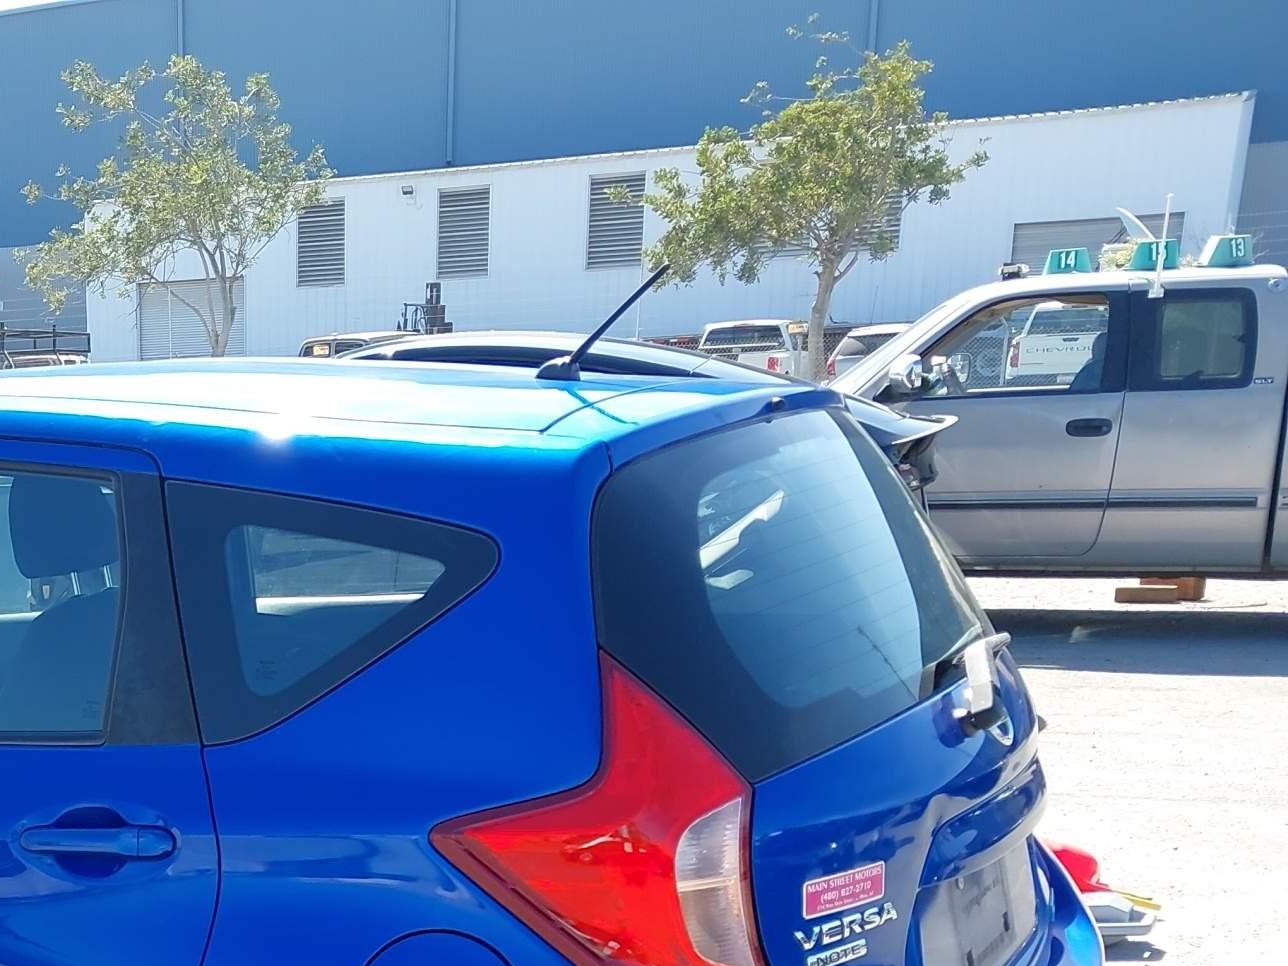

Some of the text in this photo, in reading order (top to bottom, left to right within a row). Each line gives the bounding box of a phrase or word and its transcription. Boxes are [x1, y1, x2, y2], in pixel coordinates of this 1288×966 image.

[1060, 250, 1076, 268] 14
[1230, 238, 1245, 257] 13
[807, 866, 882, 893] MAIN STREET MOTORS
[793, 902, 898, 950] VERSA
[815, 943, 863, 966] NOTE
